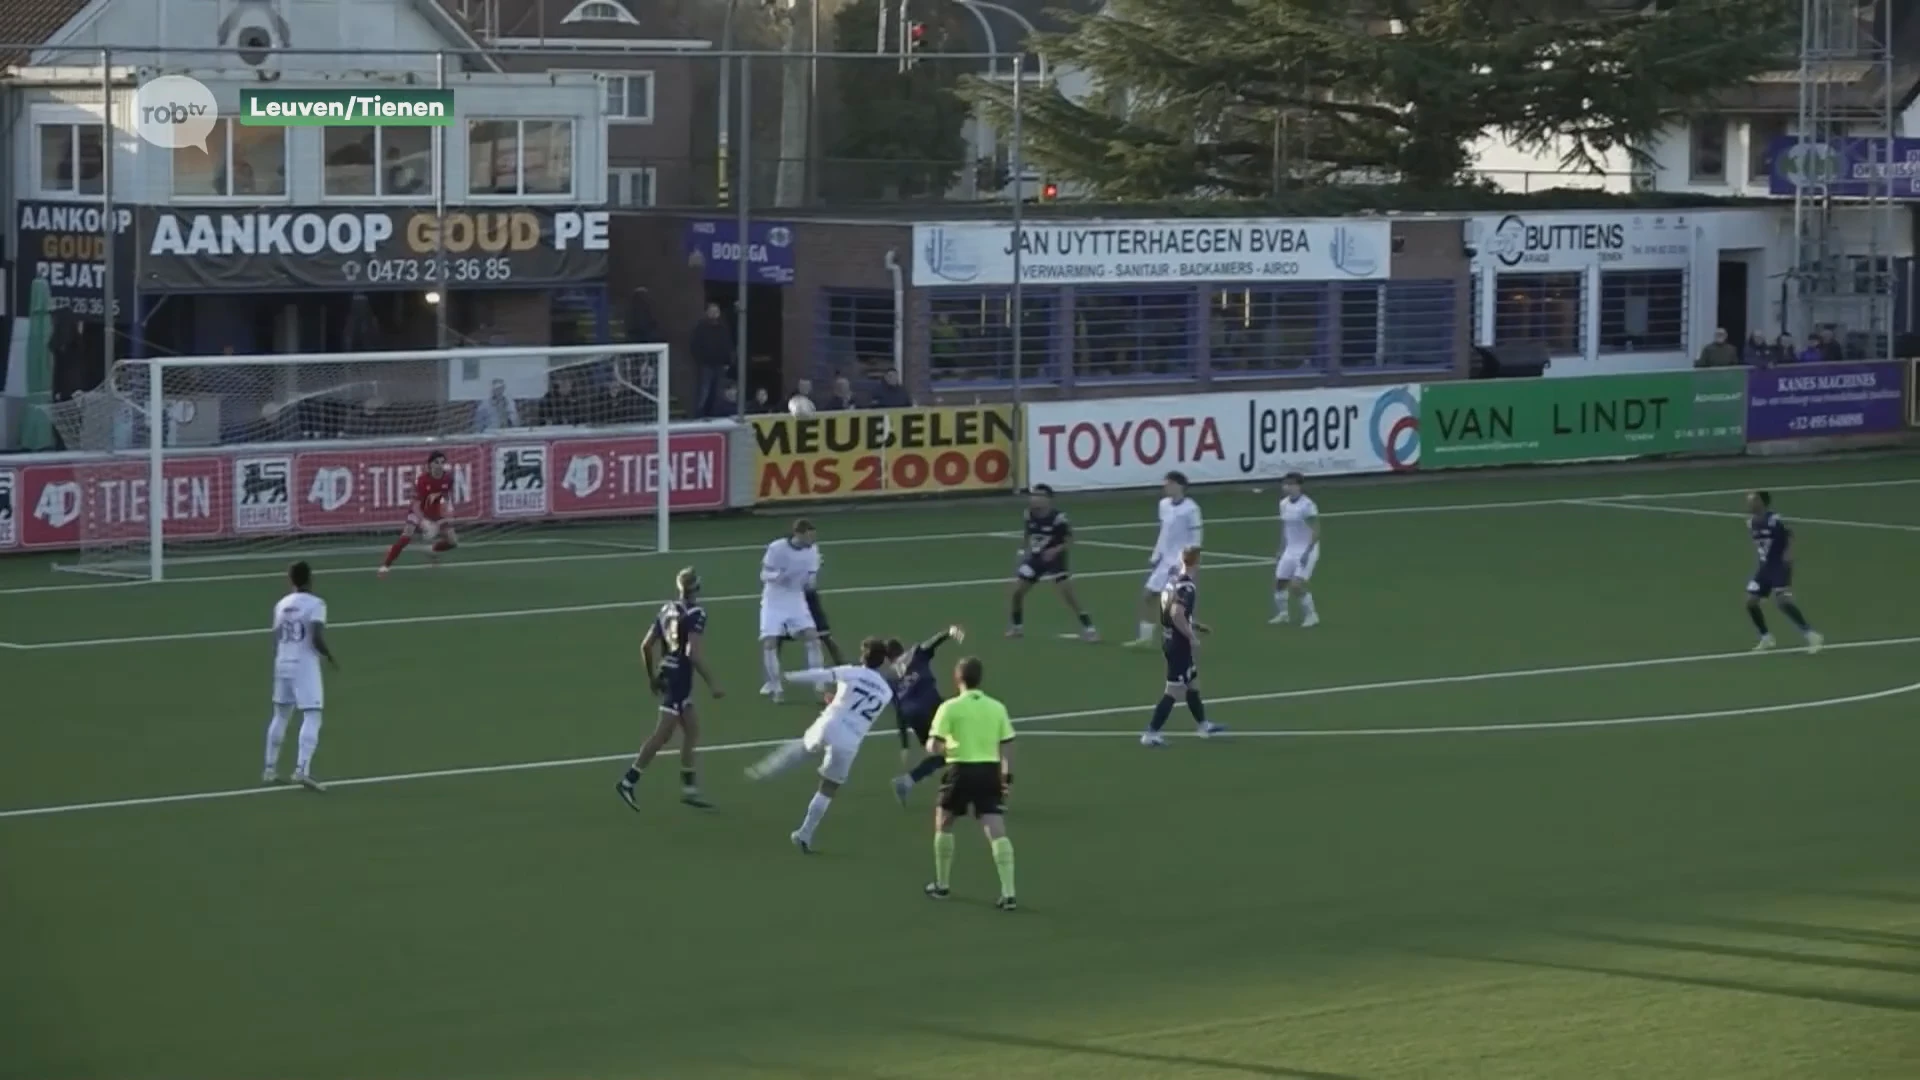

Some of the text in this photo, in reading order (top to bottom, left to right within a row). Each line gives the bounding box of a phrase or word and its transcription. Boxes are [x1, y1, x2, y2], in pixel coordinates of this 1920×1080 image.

[151, 211, 610, 255] AANKOOP GOUD PE
[712, 242, 768, 262] BODGA
[1003, 228, 1310, 255] JAN UYTTERHAEGEN BVBA
[1525, 223, 1624, 250] BUTTIENS
[367, 259, 418, 282] 0473
[456, 258, 480, 281] 36
[485, 257, 511, 280] 85
[1022, 263, 1104, 279] VERWARMING
[1115, 262, 1168, 277] SANITAIR
[1180, 261, 1253, 277] BADKAMERS
[1263, 261, 1299, 275] AIRCO
[753, 410, 1021, 456] MEUBELEN
[1240, 399, 1358, 473] Jenaer
[1435, 397, 1670, 441] VAN LINDT
[1038, 416, 1225, 471] TOYOTA
[368, 463, 472, 508] TIEN
[618, 450, 714, 494] TIENEN
[759, 448, 1010, 497] MS 2000
[851, 686, 883, 722] 72
